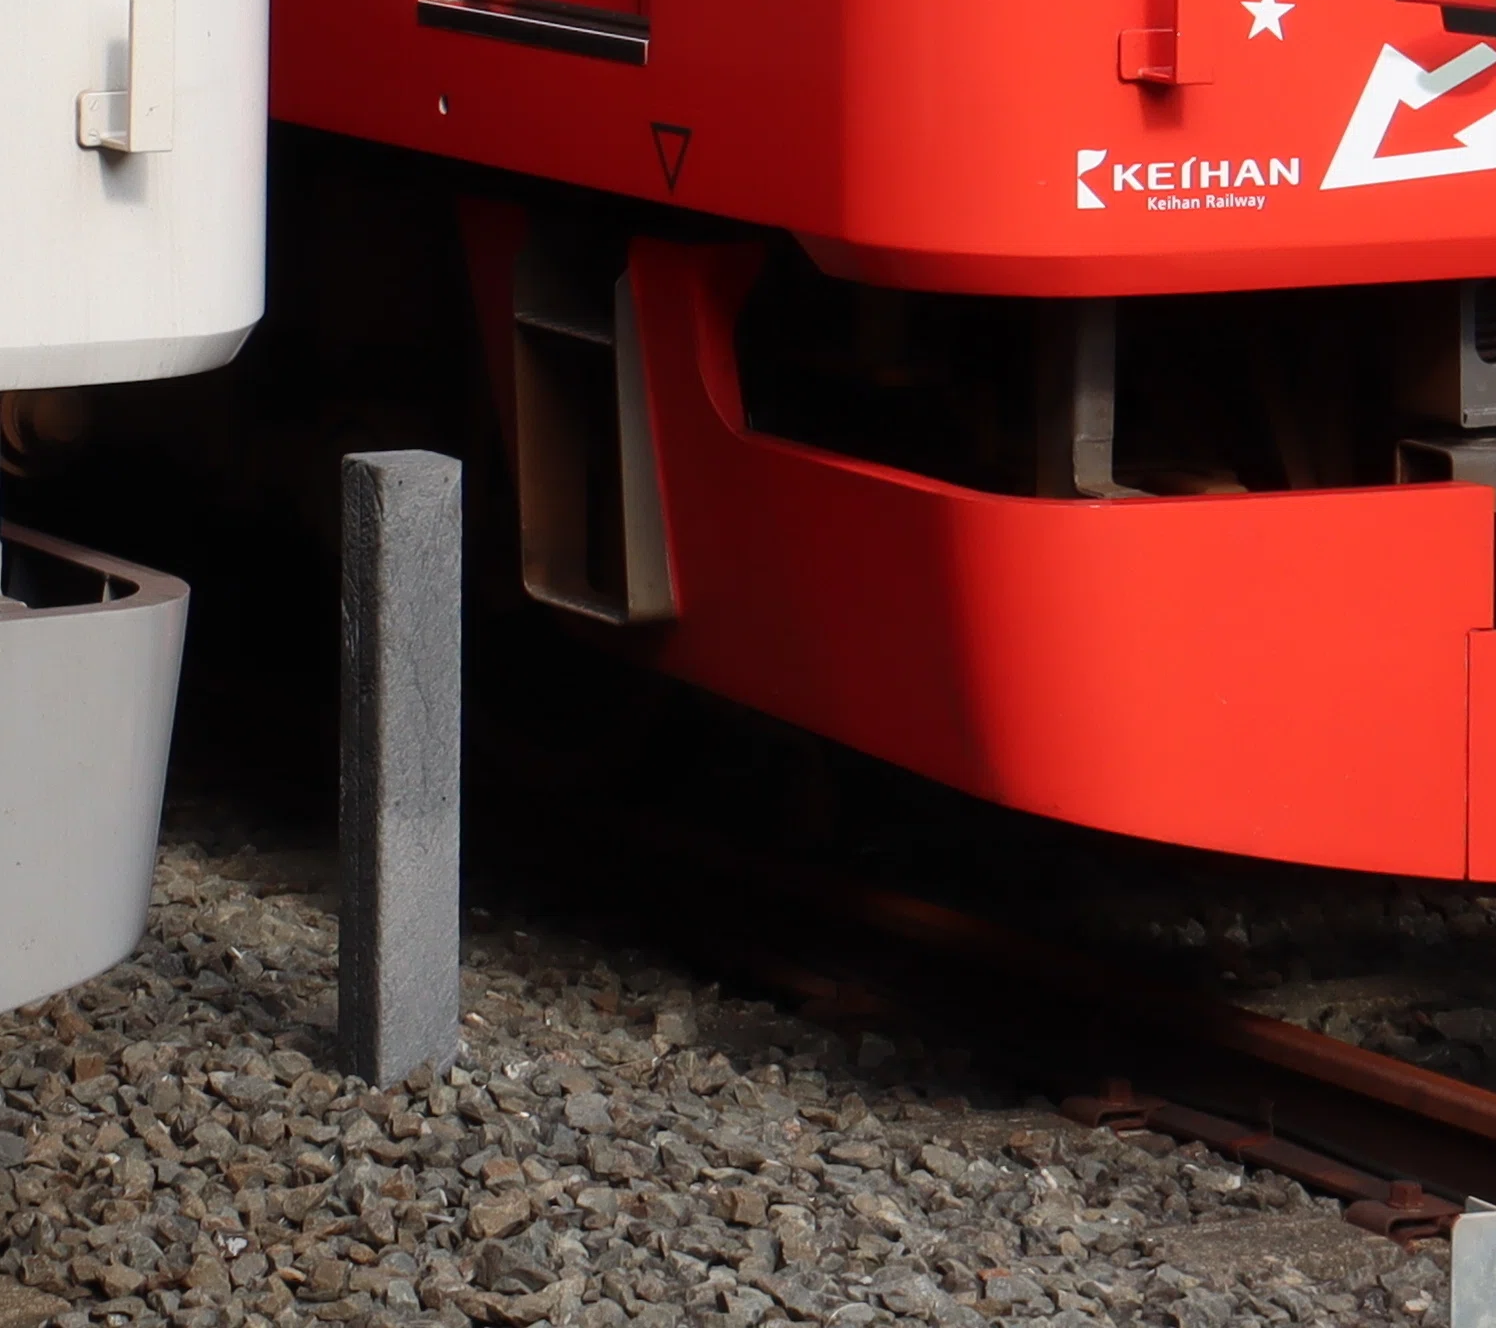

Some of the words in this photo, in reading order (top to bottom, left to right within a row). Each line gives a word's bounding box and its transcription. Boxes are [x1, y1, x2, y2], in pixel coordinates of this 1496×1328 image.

[1113, 156, 1300, 192] KEIHAN
[1147, 196, 1201, 211] Keihan
[1205, 193, 1265, 211] Railway
